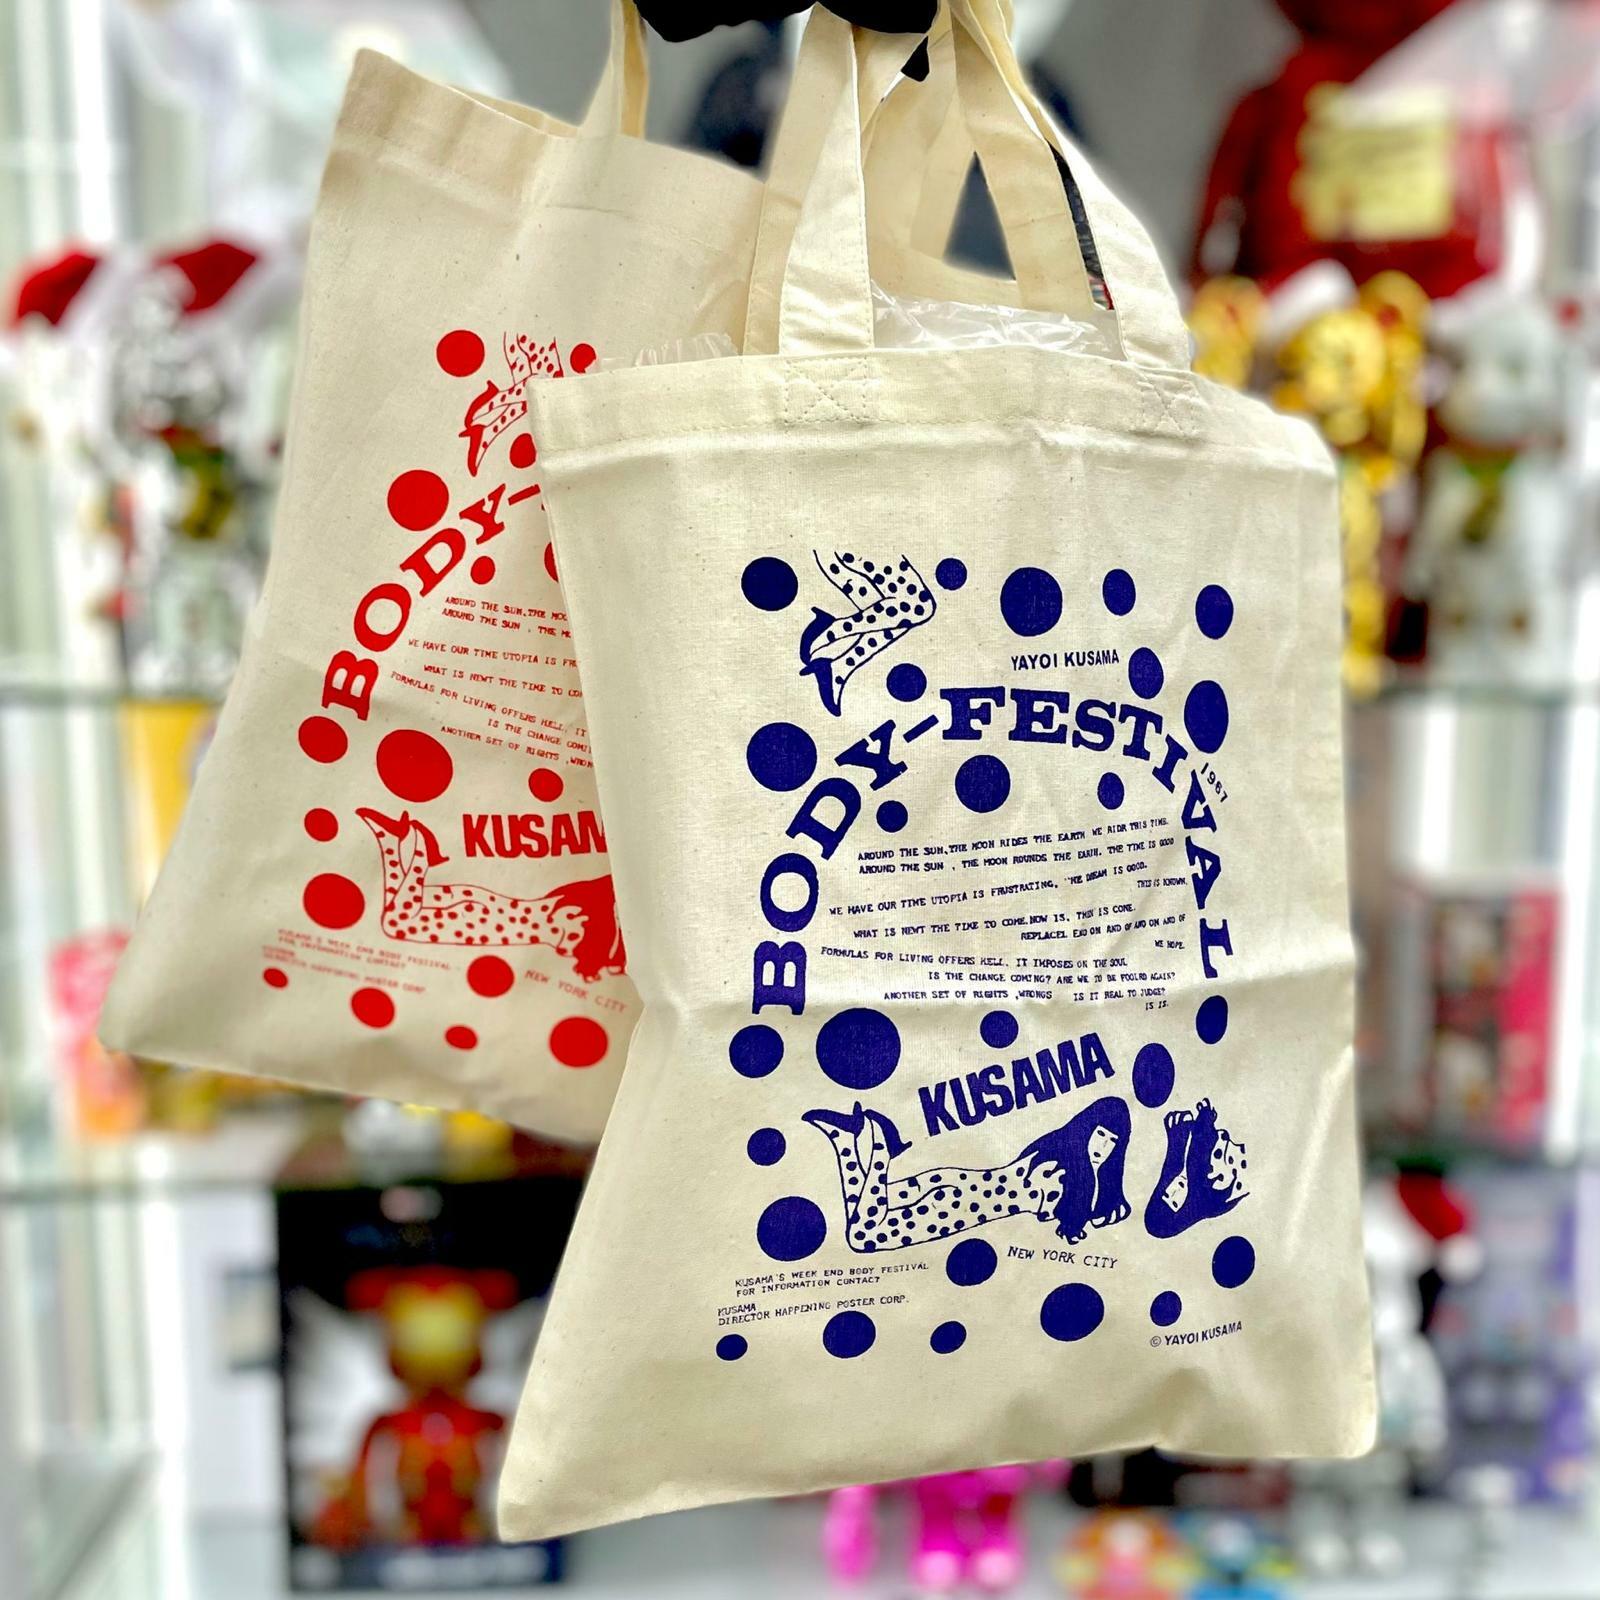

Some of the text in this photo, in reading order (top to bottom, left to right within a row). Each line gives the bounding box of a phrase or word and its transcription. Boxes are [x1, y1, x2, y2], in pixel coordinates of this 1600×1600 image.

[445, 597, 476, 608] AROUND
[481, 602, 499, 612] THE
[442, 608, 556, 636] AROUND THE SUN THE
[408, 639, 556, 666] WE HAVE OUR TIME UTOPIA IS
[1011, 650, 1120, 670] YAYOI KUSAMA
[424, 664, 448, 676] WHAT
[452, 670, 464, 679] IS
[499, 678, 517, 688] THE
[522, 682, 546, 692] TIME
[551, 686, 563, 696] TO
[390, 671, 435, 694] FORMULAS
[440, 688, 458, 700] FOR
[463, 696, 497, 713] LIVING
[501, 708, 536, 724] OFFERS
[576, 728, 586, 738] IT
[441, 726, 481, 741] ANOTHER
[486, 736, 503, 747] SET
[508, 742, 520, 751] OF
[526, 746, 560, 760] RIGHTS
[488, 718, 498, 728] IS
[504, 724, 521, 735] THE
[528, 730, 561, 746] CHANGE
[1200, 762, 1228, 803] 1967
[858, 850, 894, 860] AROUND
[900, 848, 919, 858] THE
[972, 840, 994, 850] MOON
[1000, 836, 1028, 847] RIDES
[1033, 834, 1052, 844] THE
[1058, 831, 1086, 842] EARTH
[1092, 828, 1102, 836] WE
[1130, 820, 1148, 831] THIS
[859, 864, 896, 874] AROUND
[900, 862, 920, 872] THE
[924, 862, 944, 872] SUN
[962, 859, 979, 868] THE
[984, 857, 1008, 866] MOON
[1012, 854, 1048, 864] ROUNDS
[1053, 852, 1072, 862] THE
[1106, 845, 1124, 855] THE
[1148, 840, 1156, 848] IS
[829, 906, 843, 916] WE
[848, 904, 874, 914] HAVE
[878, 901, 896, 911] OUR
[901, 898, 926, 908] TIME
[931, 892, 968, 905] UTOPIA
[973, 890, 984, 899] IS
[1114, 866, 1124, 875] IS
[1153, 878, 1160, 888] IS
[854, 929, 878, 938] WHAT
[884, 928, 896, 937] IS
[931, 924, 950, 933] THE
[954, 921, 979, 932] TIME
[984, 920, 997, 930] TO
[1098, 906, 1108, 916] IS
[1154, 939, 1164, 948] WE
[821, 946, 868, 958] FORMULAS
[874, 952, 894, 961] FOR
[900, 953, 934, 964] LIVING
[938, 956, 975, 966] OFFERS
[1016, 958, 1028, 968] IT
[1033, 958, 1074, 969] IMPOSES
[1076, 960, 1088, 968] ON
[1092, 959, 1108, 968] THE
[525, 970, 626, 1013] NEW YORK CITY
[928, 972, 940, 980] IS
[945, 972, 964, 980] THE
[969, 973, 1006, 982] CHANGE
[1010, 974, 1052, 983] COMING?
[1056, 976, 1074, 984] ARE
[1078, 974, 1090, 983] WE
[1107, 974, 1116, 982] BE
[884, 991, 927, 1000] ANOTHER
[932, 990, 950, 998] SET
[955, 990, 966, 998] OF
[973, 990, 1009, 998] RIGHTS
[1074, 992, 1084, 1002] IS
[1090, 992, 1099, 1000] IT
[1104, 990, 1124, 1000] REAL
[1128, 988, 1137, 998] TO
[1140, 987, 1166, 998] JUDGE?
[1145, 1002, 1154, 1010] IS
[918, 1032, 1115, 1137] KUSAMA
[792, 1270, 817, 1278] WEEK
[850, 1268, 874, 1276] BODY
[882, 1263, 928, 1274] FESTIVAL
[1008, 1246, 1118, 1269] NEW YORK CITY
[736, 1288, 755, 1297] FOR
[762, 1280, 830, 1294] INFORMATION
[718, 1303, 756, 1316] KUSAMA
[718, 1295, 910, 1326] DIRECTOR HAPPENING POSTER CORP.
[1164, 1332, 1198, 1346] YAYOI
[1202, 1320, 1242, 1342] KUSAMA
